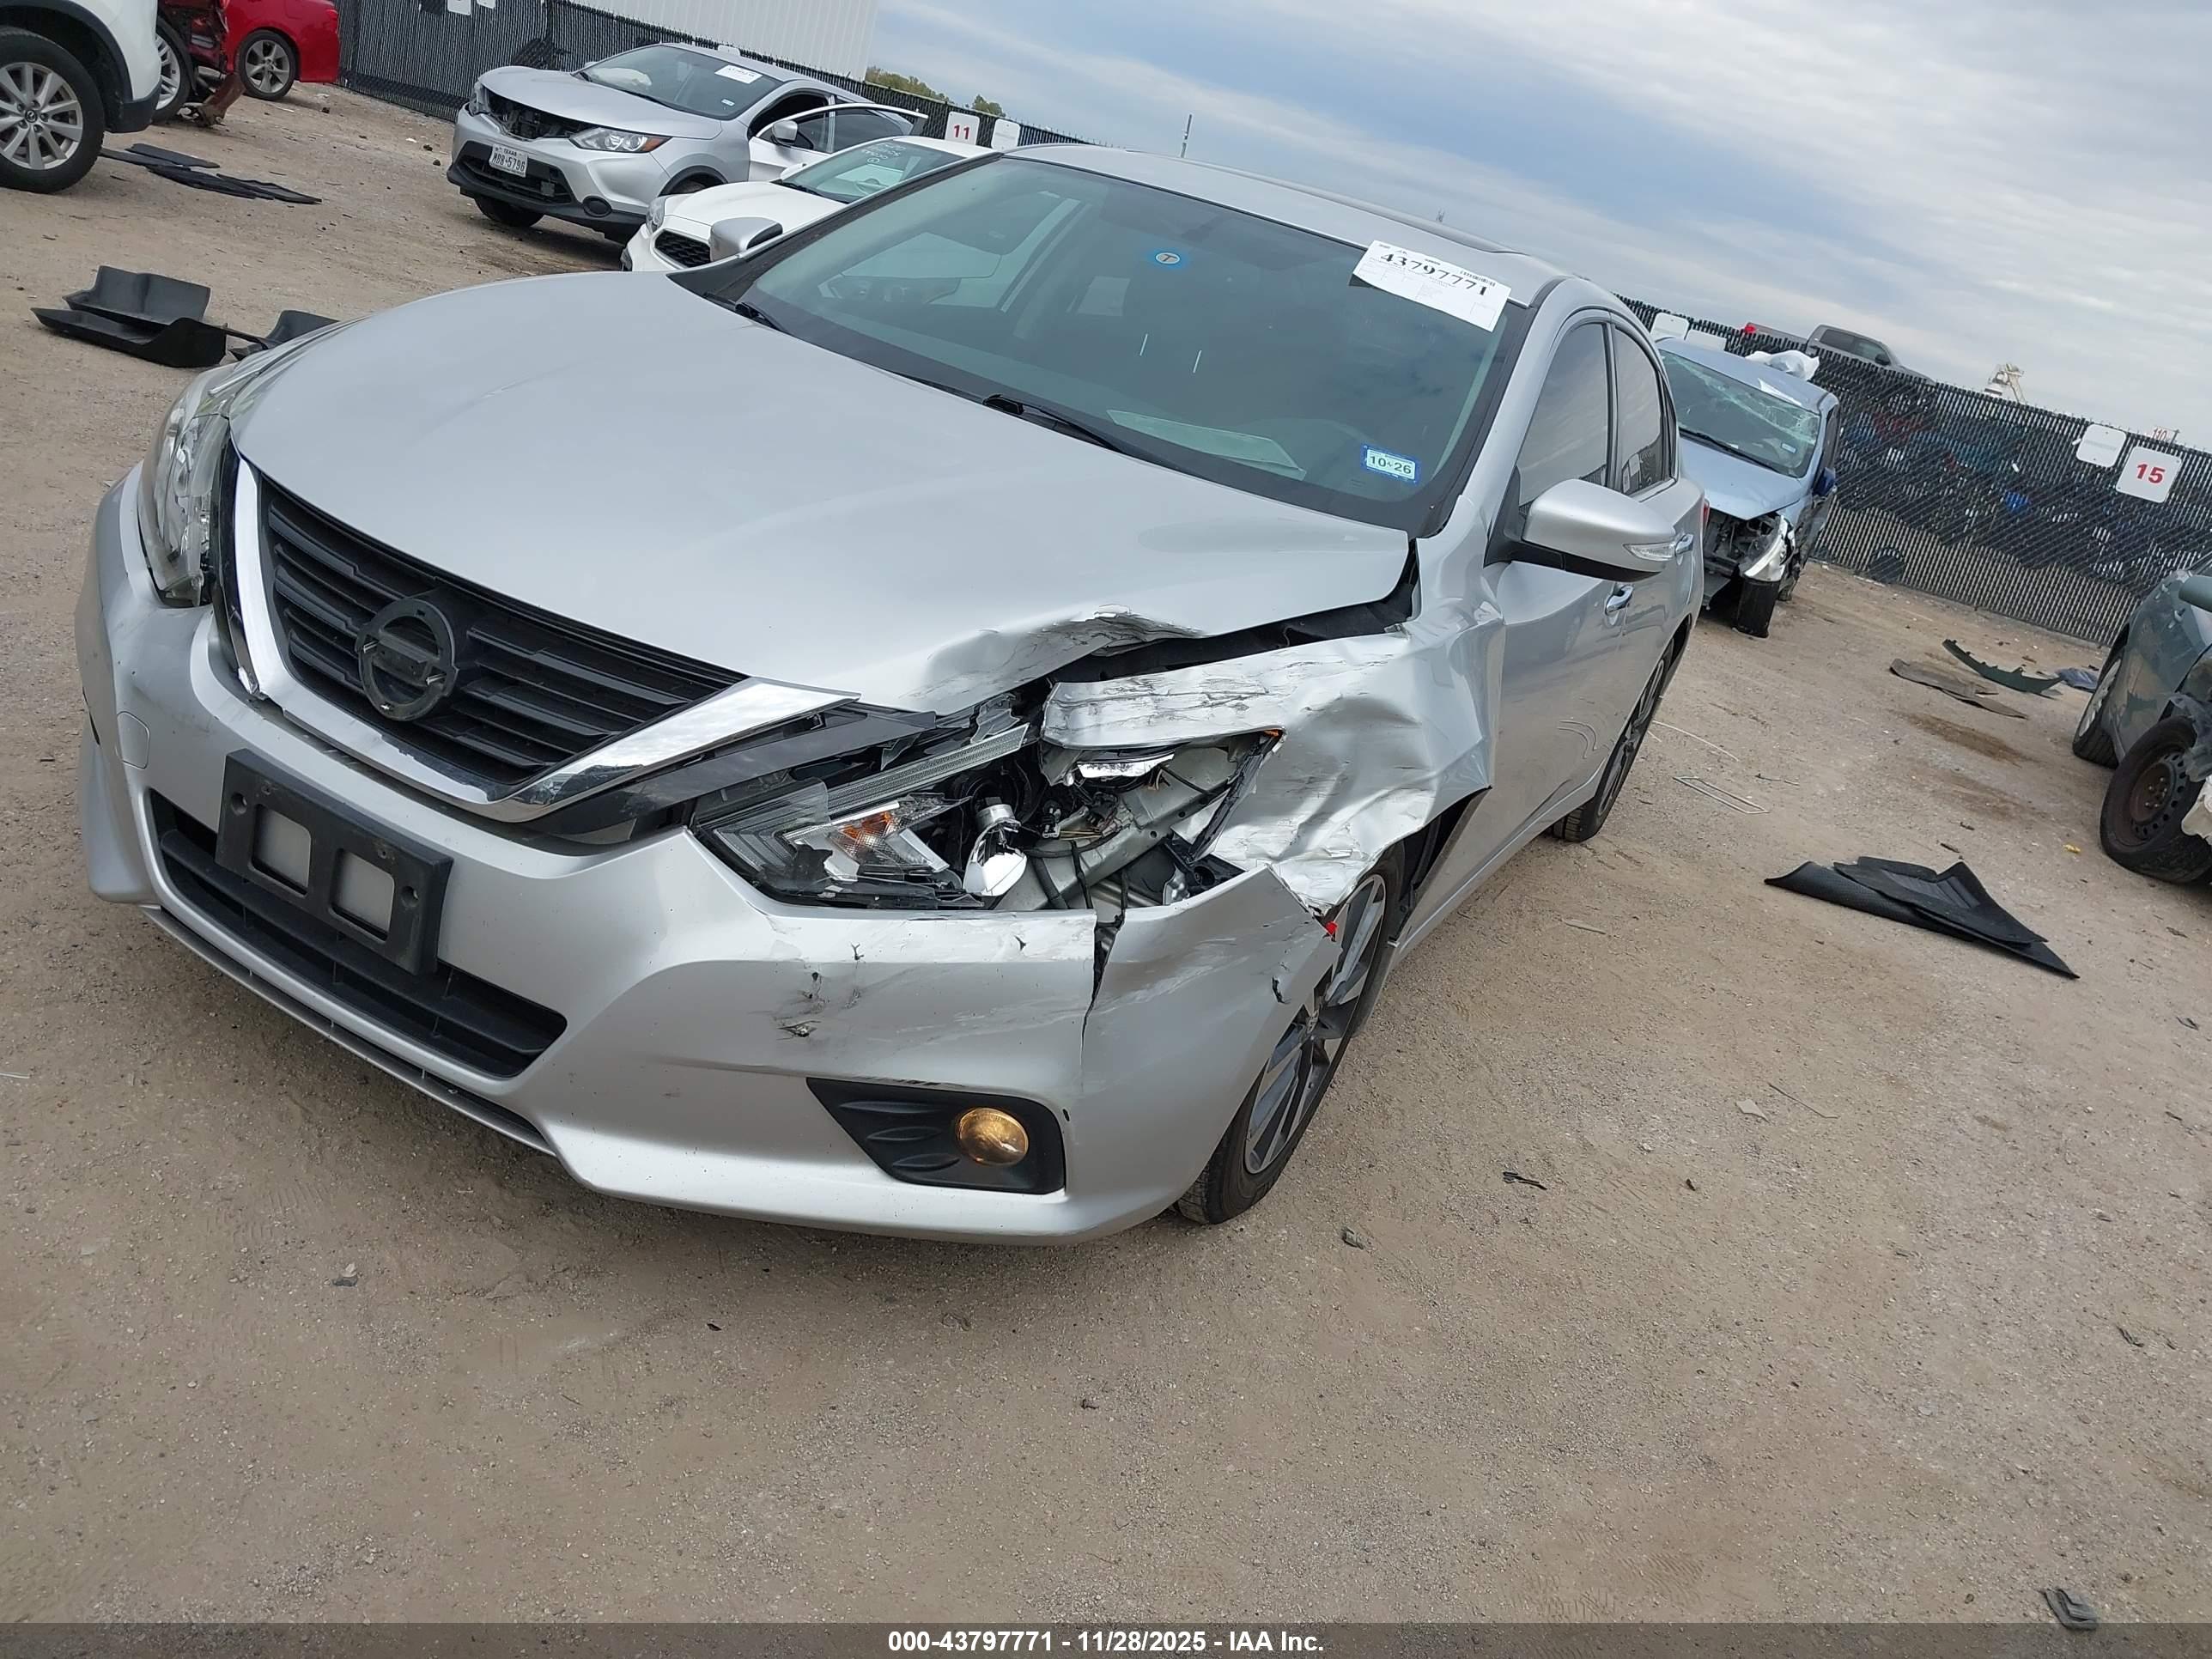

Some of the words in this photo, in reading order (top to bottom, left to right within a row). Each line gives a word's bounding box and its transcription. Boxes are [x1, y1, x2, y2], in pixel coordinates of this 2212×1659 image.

[954, 125, 970, 140] 11
[1380, 253, 1487, 296] 43797771
[2136, 464, 2166, 483] 15
